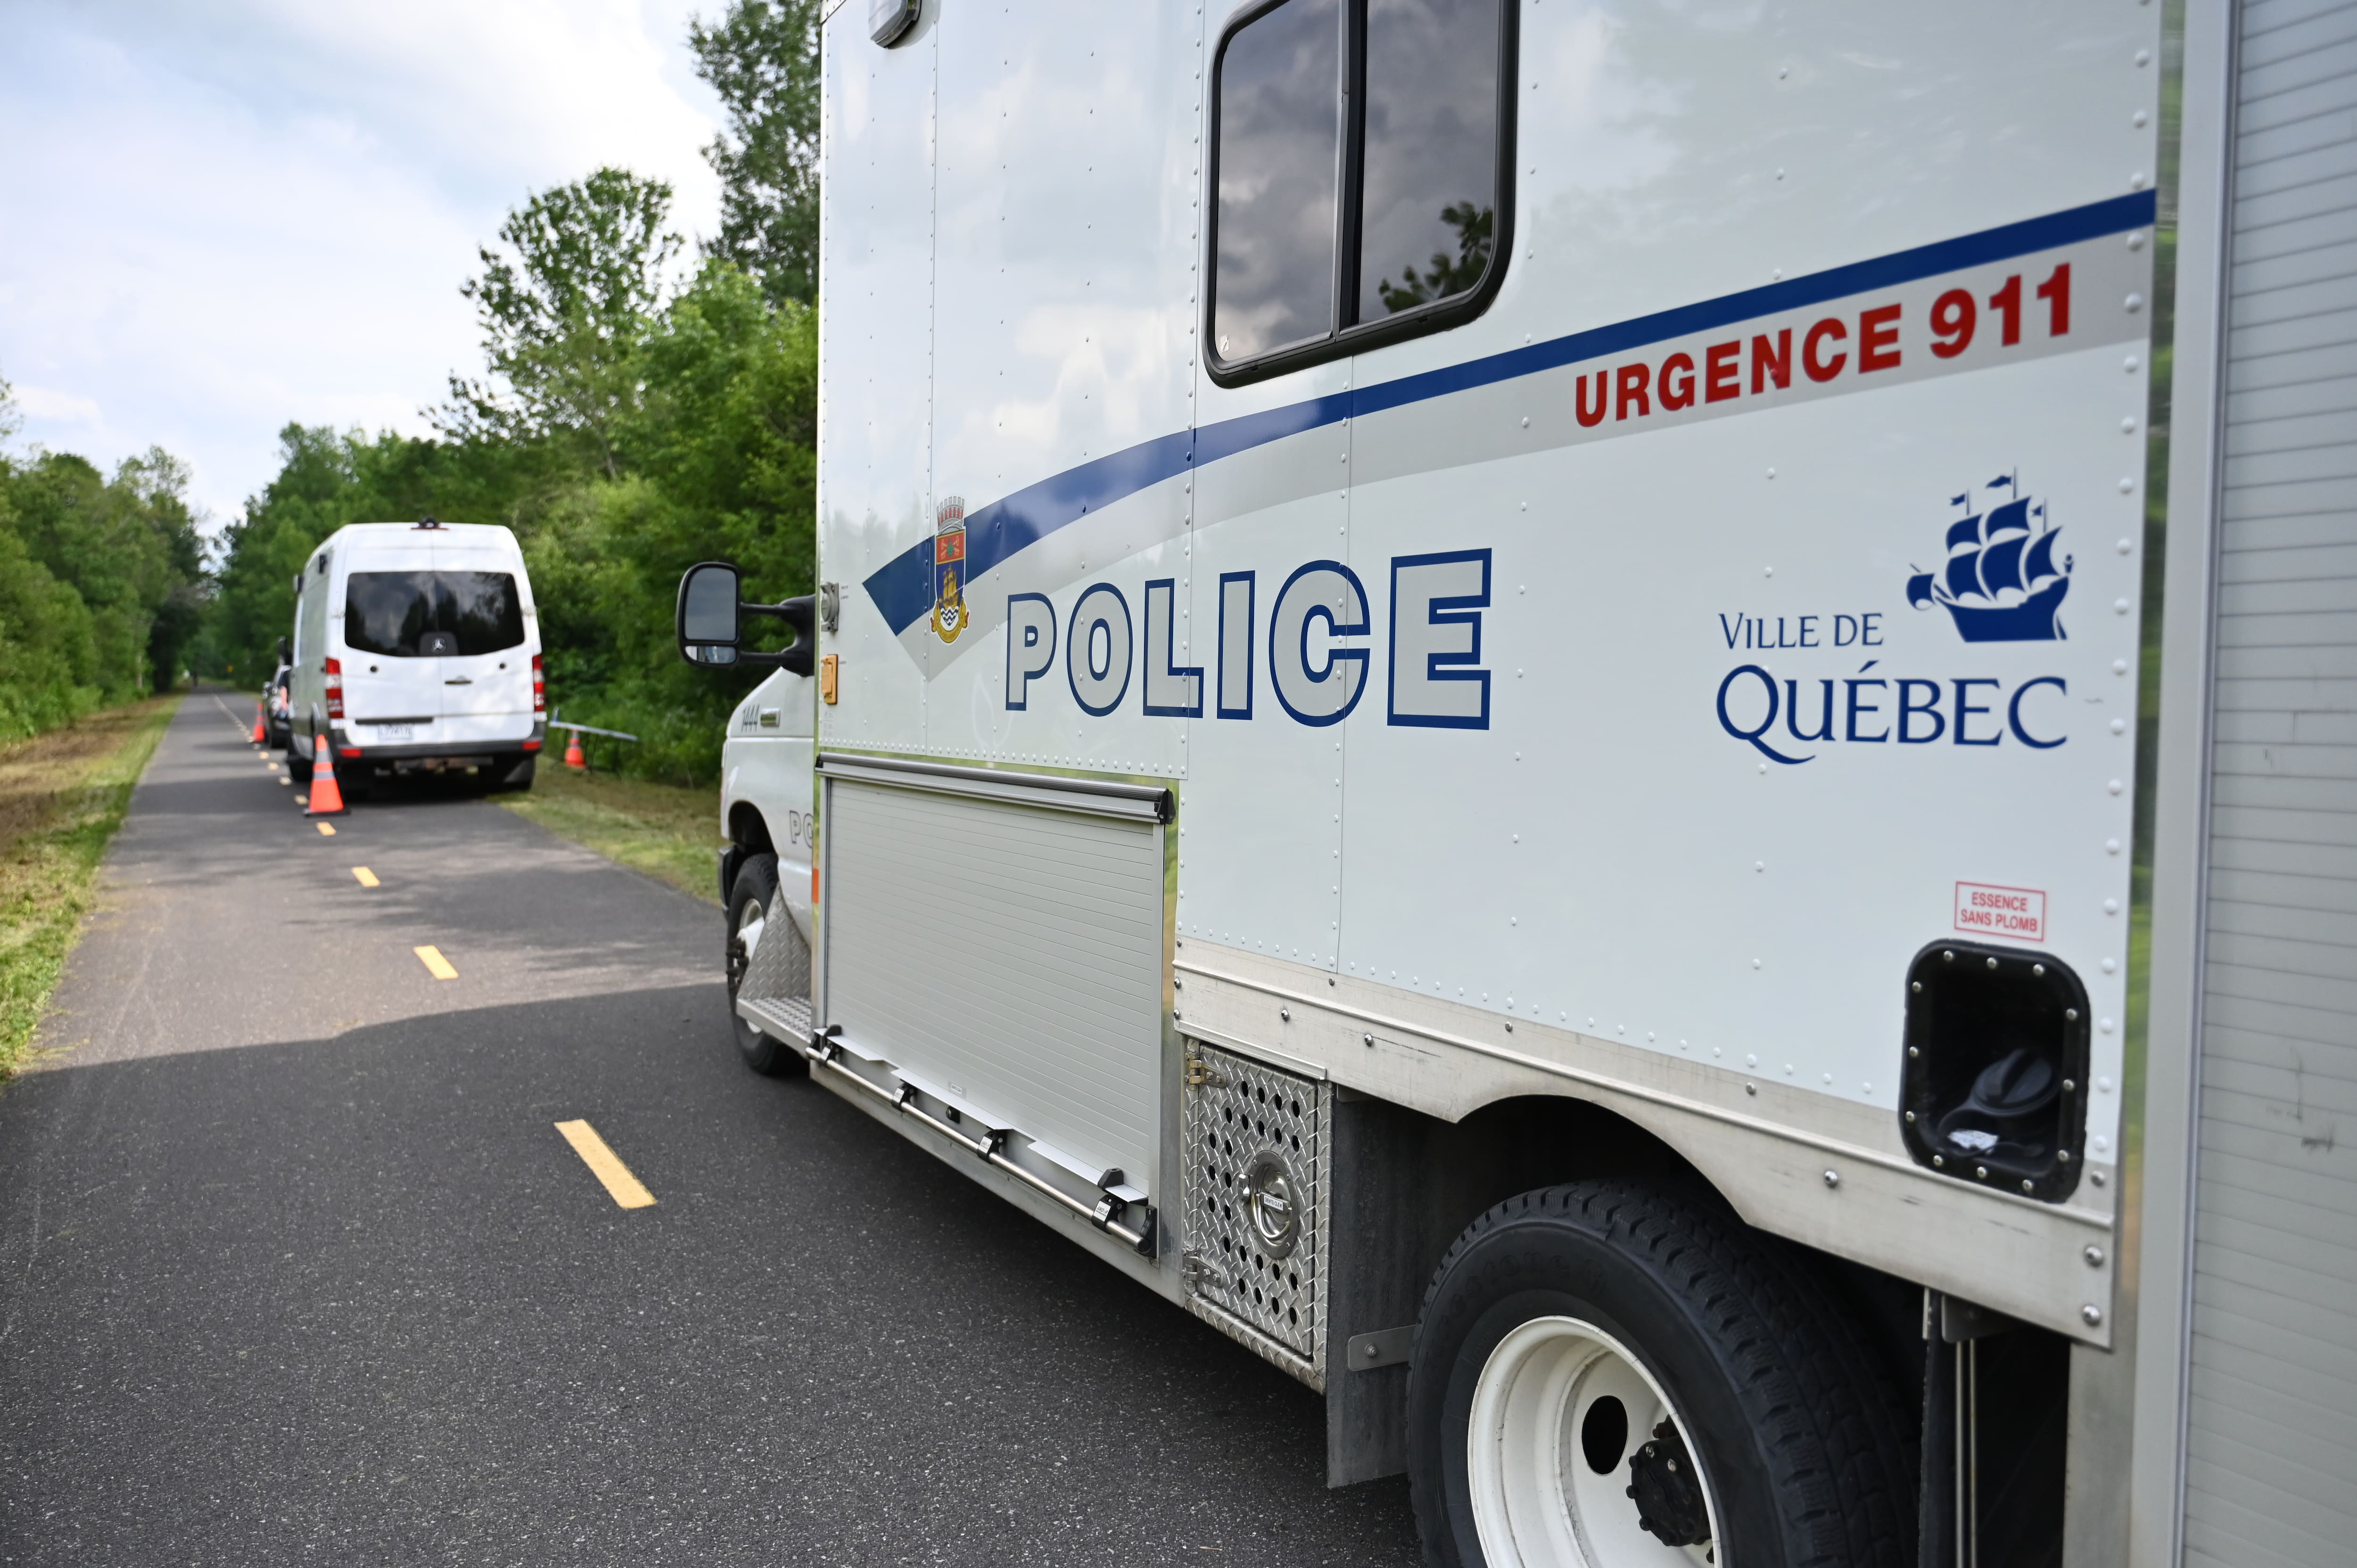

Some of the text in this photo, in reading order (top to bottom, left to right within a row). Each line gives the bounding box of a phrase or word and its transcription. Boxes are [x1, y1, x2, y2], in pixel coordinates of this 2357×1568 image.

[1575, 263, 2071, 427] URGENCE 911
[1005, 548, 1492, 731] POLICE
[1718, 612, 1884, 649] VILLE DE
[741, 703, 760, 732] 1444
[1716, 660, 2067, 765] QUÉBEC
[1960, 908, 2038, 932] SANS PLOMB
[1971, 891, 2028, 912] ESSENCE
